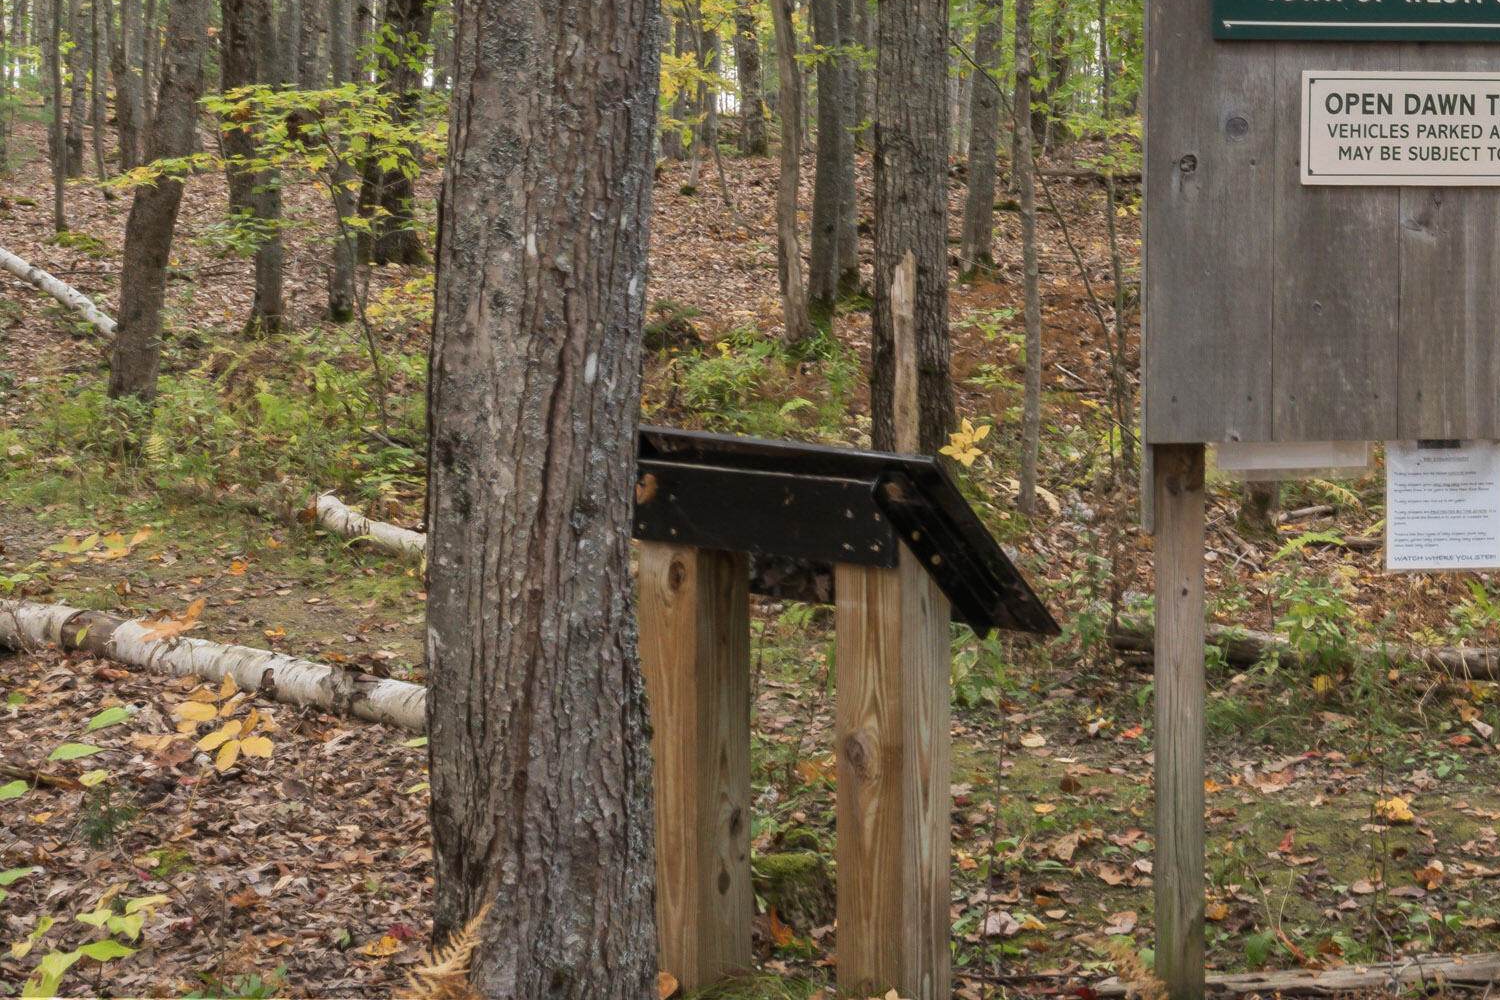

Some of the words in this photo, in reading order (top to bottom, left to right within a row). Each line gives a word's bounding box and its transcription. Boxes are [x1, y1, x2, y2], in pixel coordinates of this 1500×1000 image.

[1324, 92, 1393, 115] OPEN
[1404, 93, 1476, 116] DAWN
[1327, 123, 1410, 139] VEHICLES
[1416, 123, 1483, 140] PARKED
[1338, 145, 1374, 161] MAY
[1380, 145, 1402, 161] BE
[1408, 145, 1481, 162] SUBJECT
